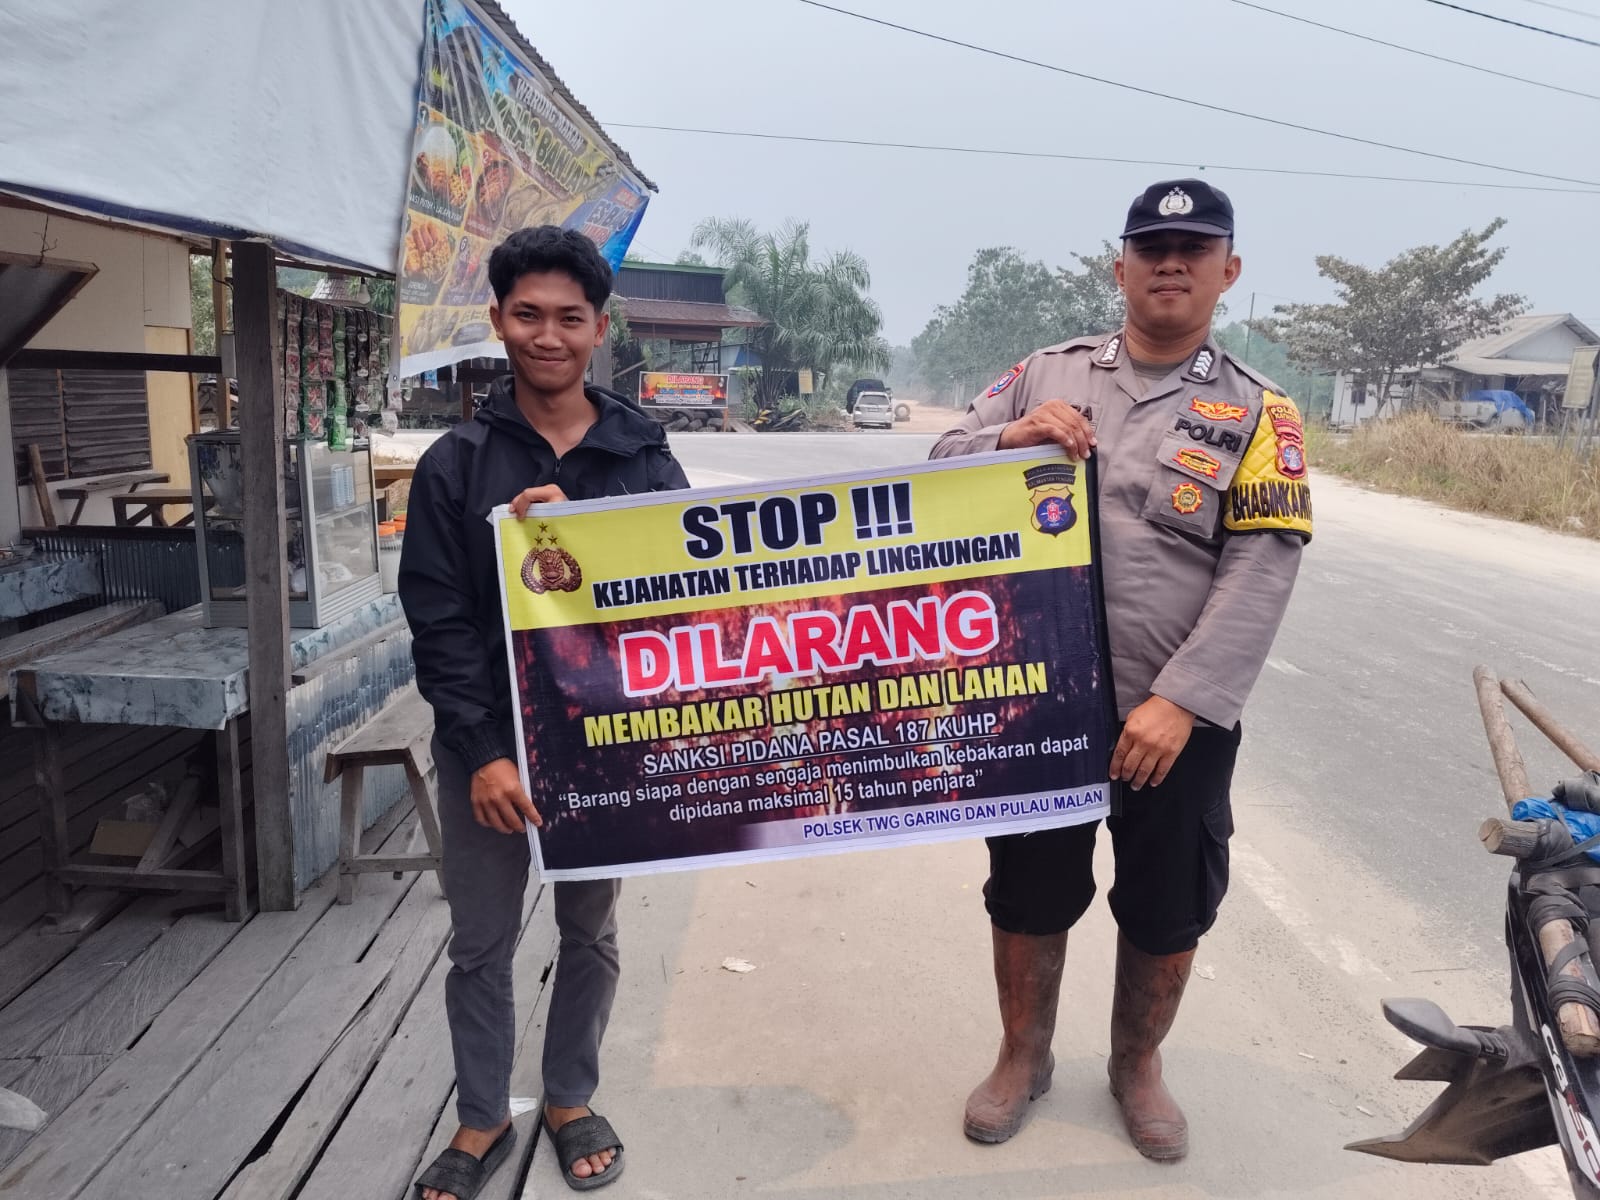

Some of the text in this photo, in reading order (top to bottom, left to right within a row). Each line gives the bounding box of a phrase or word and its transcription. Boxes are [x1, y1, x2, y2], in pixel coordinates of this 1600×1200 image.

[515, 77, 585, 151] WARUNG MAKAN
[1174, 419, 1243, 453] POLRI
[683, 482, 913, 559] STOP !!!
[592, 532, 1021, 609] KEJAHATAN TERHADAP LINGKUNGAN
[620, 592, 998, 696] DILARANG
[583, 662, 1049, 747] MEMBAKAR HUTAN DAN LAHAN
[558, 733, 1089, 809] “Barang siapa dengan sengaja menimbulkan kebakaran dapat
[643, 712, 997, 775] SANKSI PIDANA PASAL 187 KUHP
[669, 769, 983, 823] dipidana maksimal 15 tahun penjara”
[803, 789, 1103, 839] POLSEK TWG GARING DAN PULAU MALAN
